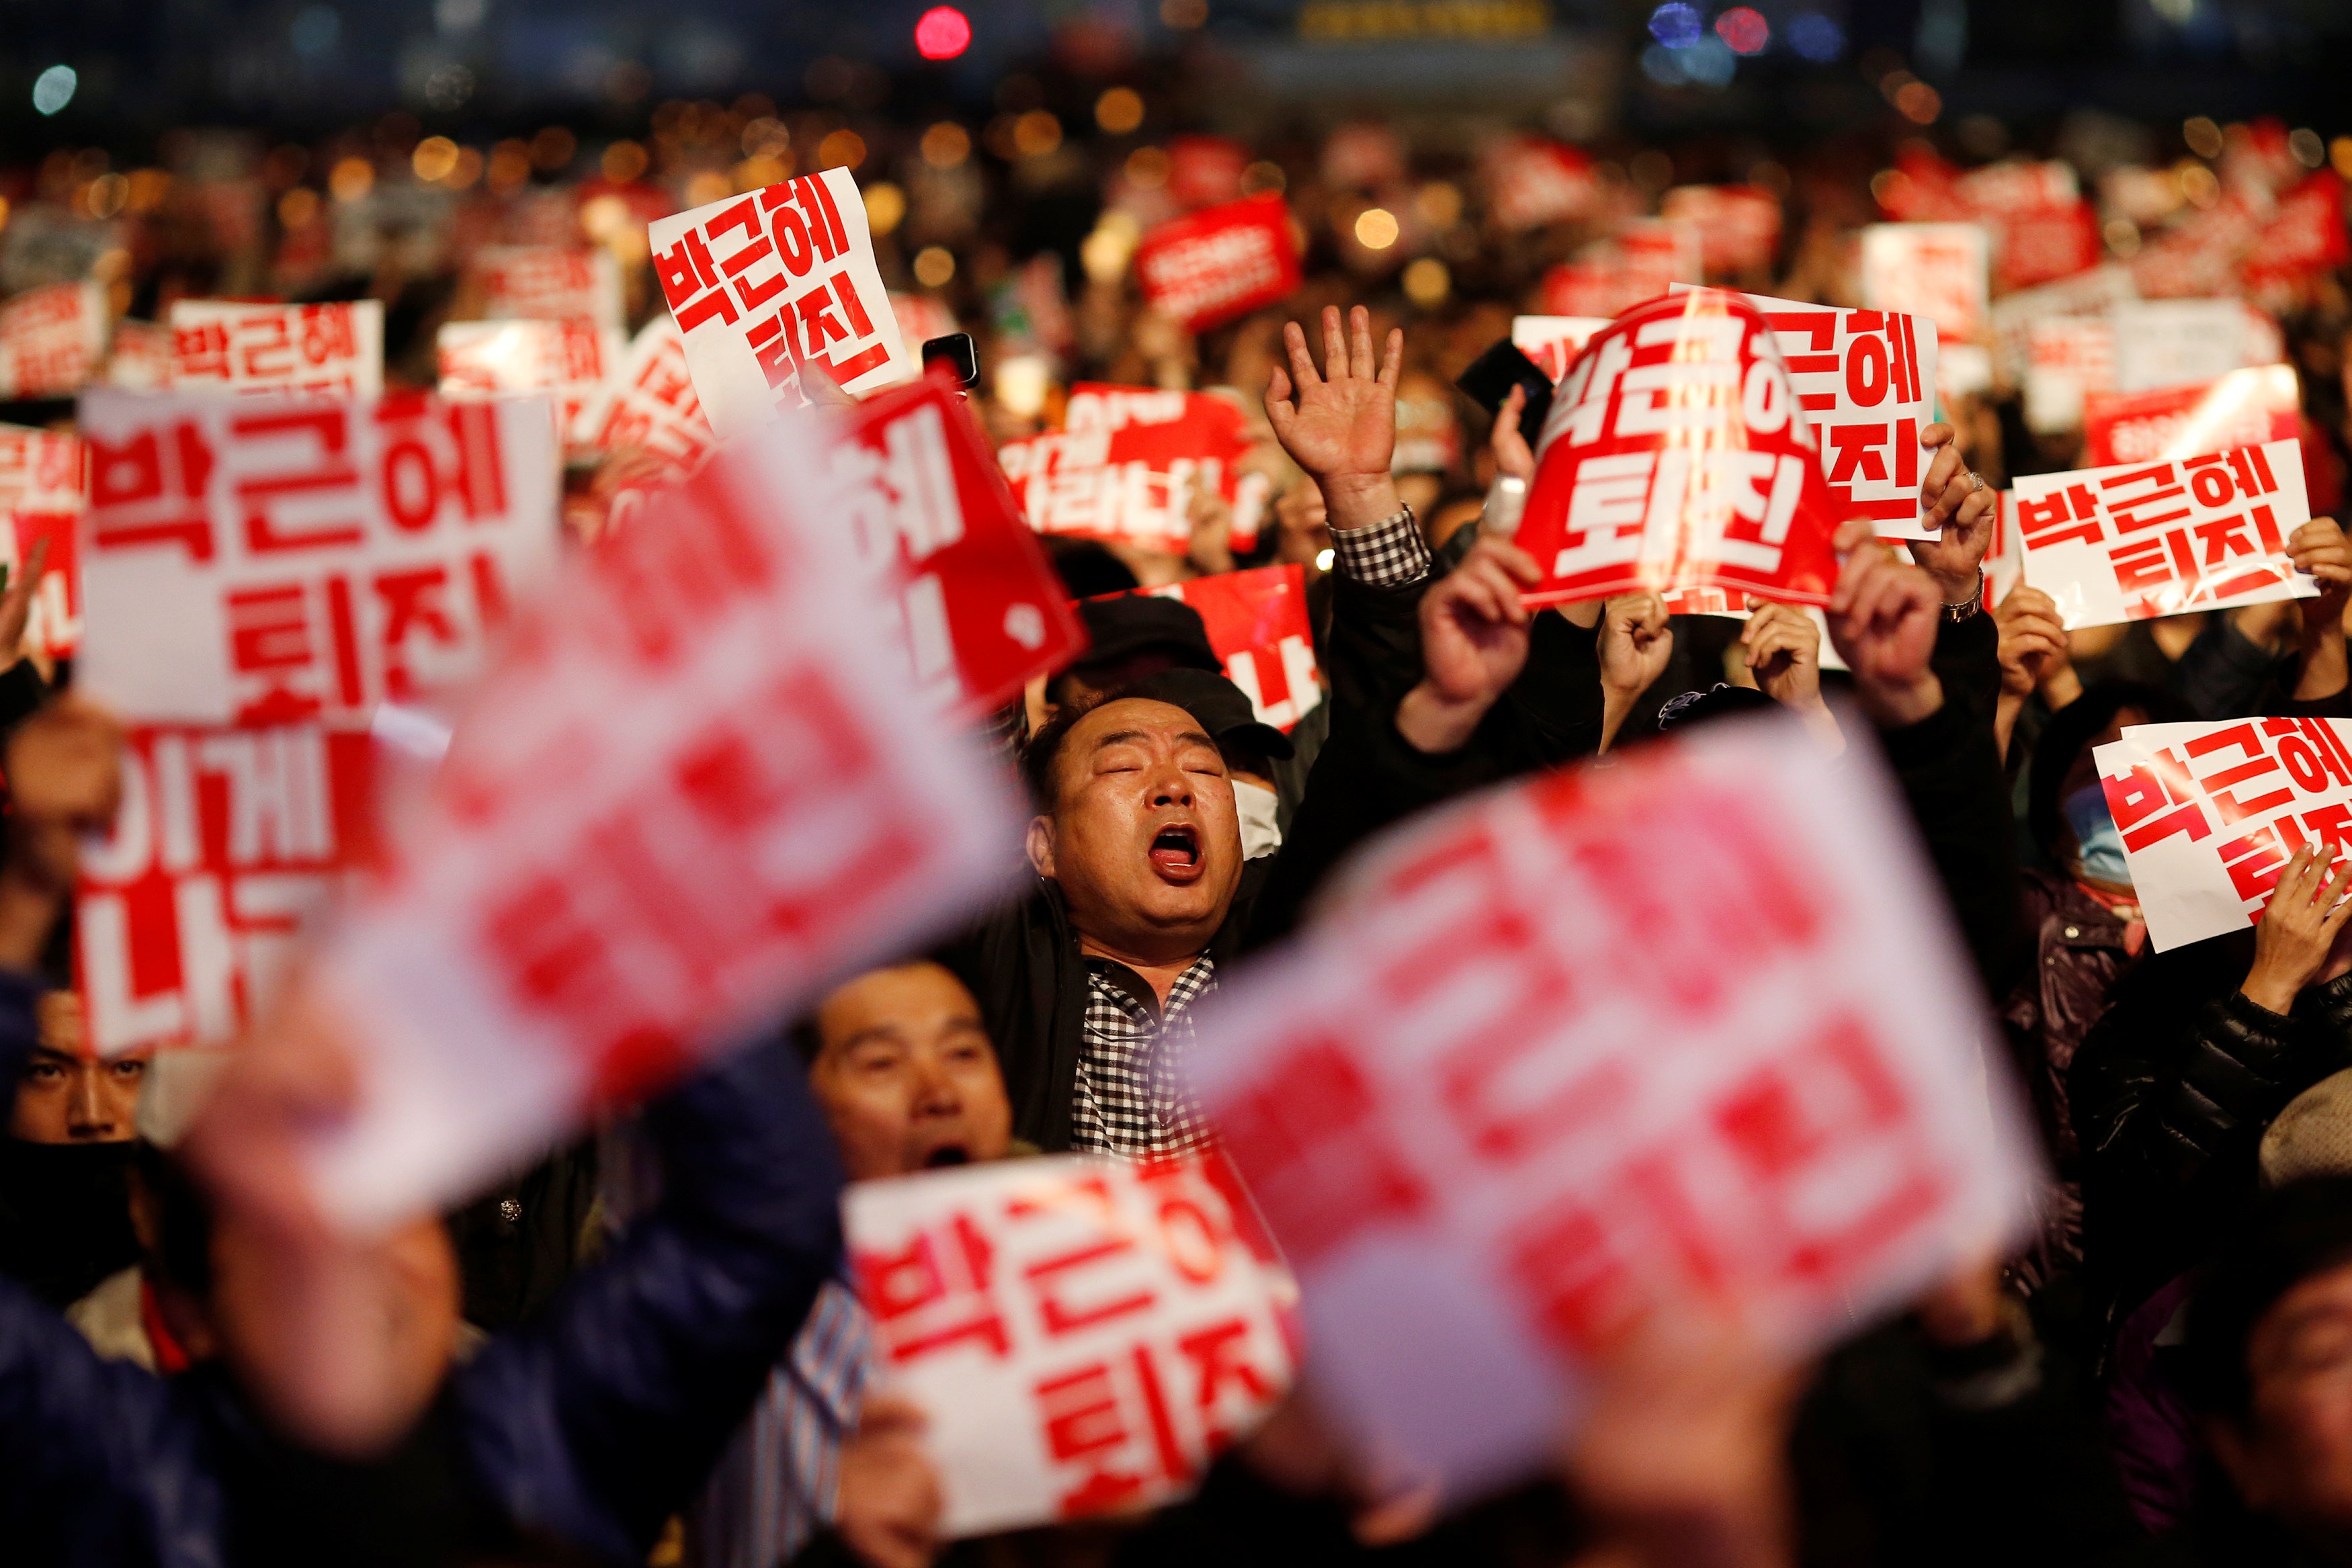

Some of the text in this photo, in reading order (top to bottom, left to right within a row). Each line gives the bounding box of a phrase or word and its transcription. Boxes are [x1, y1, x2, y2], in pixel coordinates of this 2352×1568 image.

[653, 172, 851, 334] 박근혜
[175, 301, 356, 381] 박근혜
[745, 269, 890, 420] 퇴진
[1759, 308, 1923, 411] 근혜
[86, 393, 509, 566] 박근혜
[1554, 450, 1806, 579] 퇴진
[1809, 418, 1919, 521] 진
[2017, 445, 2280, 552] 박근혜
[2108, 503, 2294, 619] 퇴진
[2099, 716, 2352, 855] 박근혜
